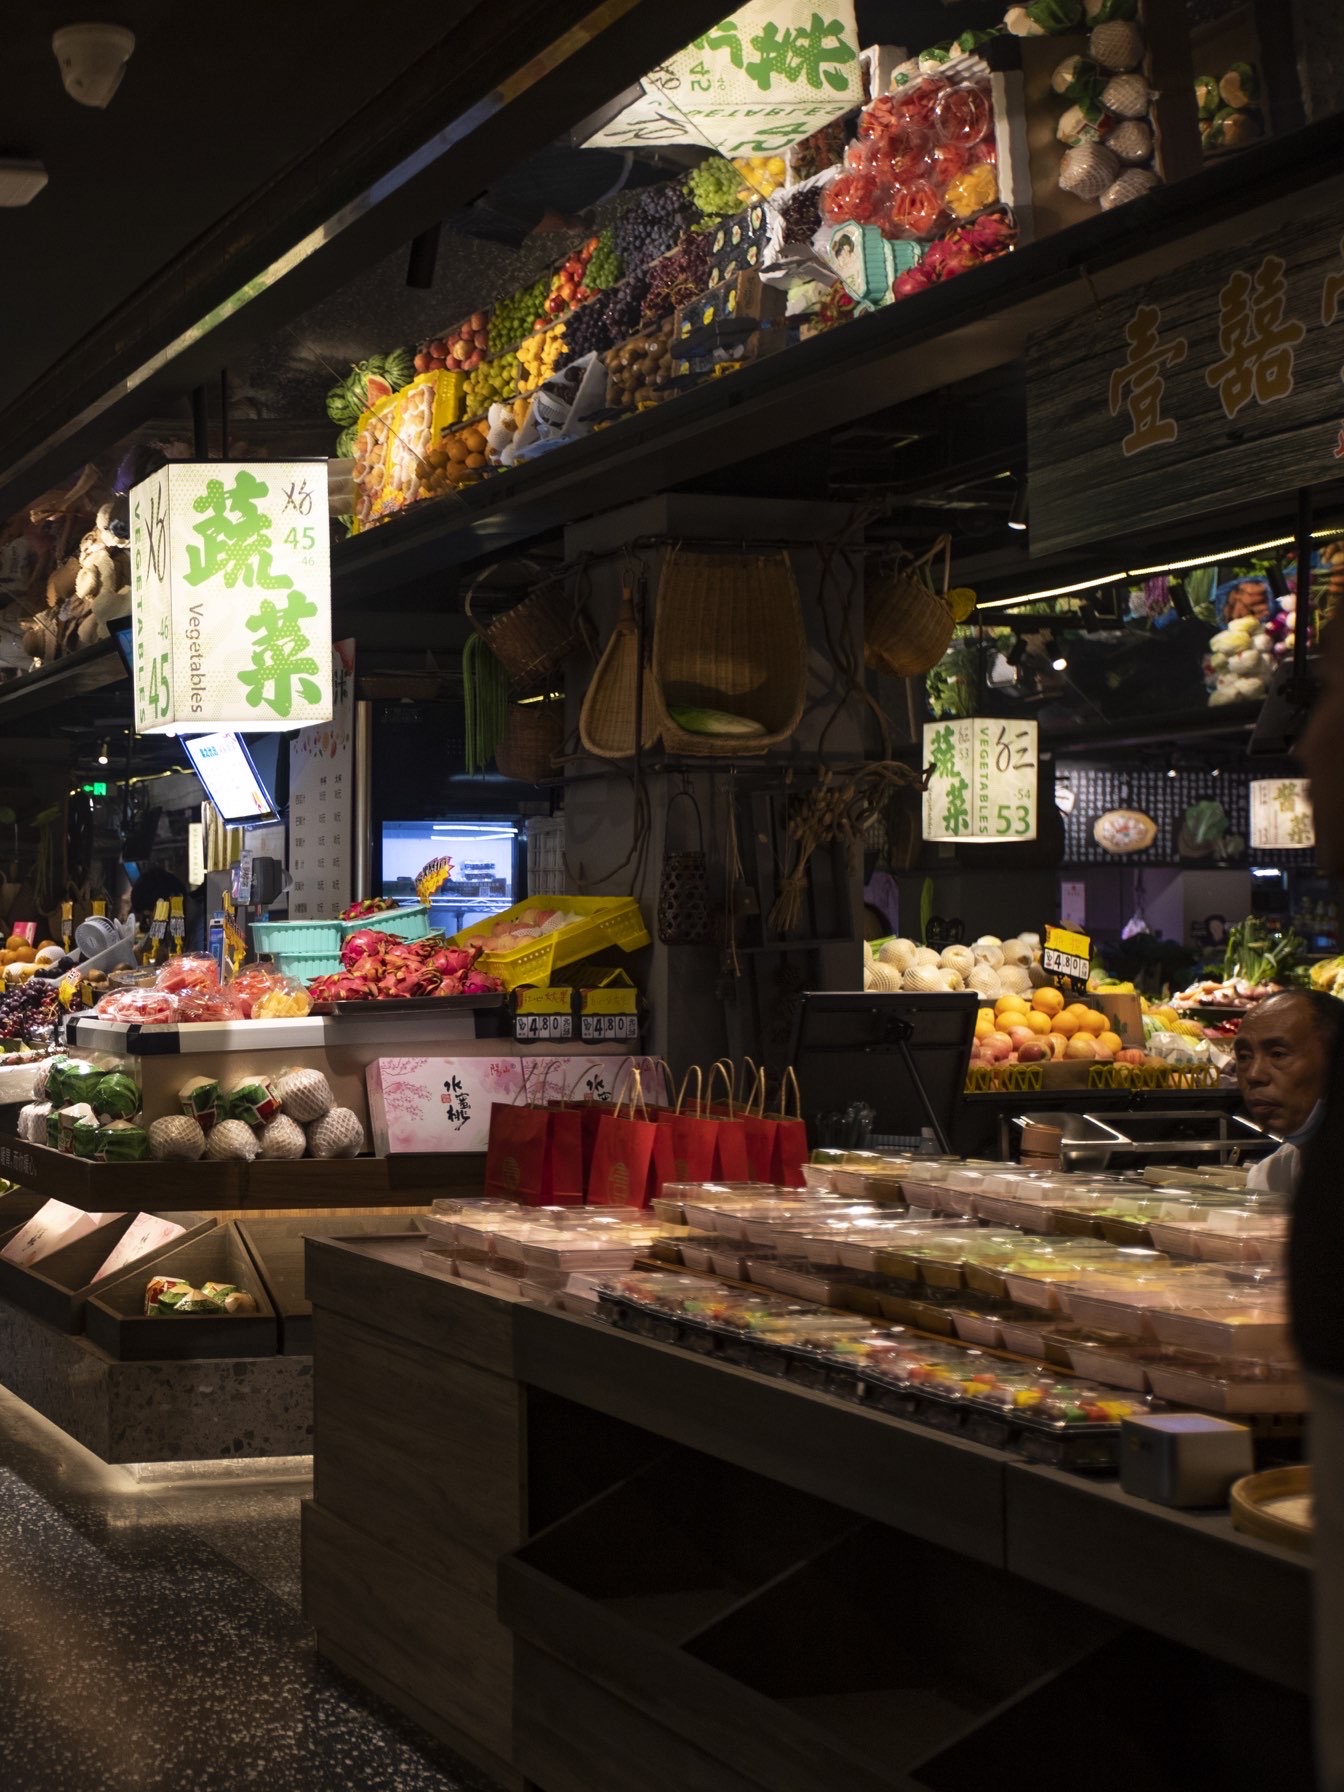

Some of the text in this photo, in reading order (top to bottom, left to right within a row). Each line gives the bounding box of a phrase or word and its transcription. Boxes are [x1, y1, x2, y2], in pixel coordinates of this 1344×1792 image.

[283, 526, 316, 551] 45
[130, 501, 146, 724] VEGETABLES
[182, 470, 323, 718] 蔬菜
[148, 652, 170, 719] 45
[186, 602, 206, 713] Vegetables
[979, 727, 990, 834] VEGETABLES
[996, 805, 1031, 835] 53
[529, 1017, 559, 1037] 4.80
[594, 1017, 624, 1037] 4.80
